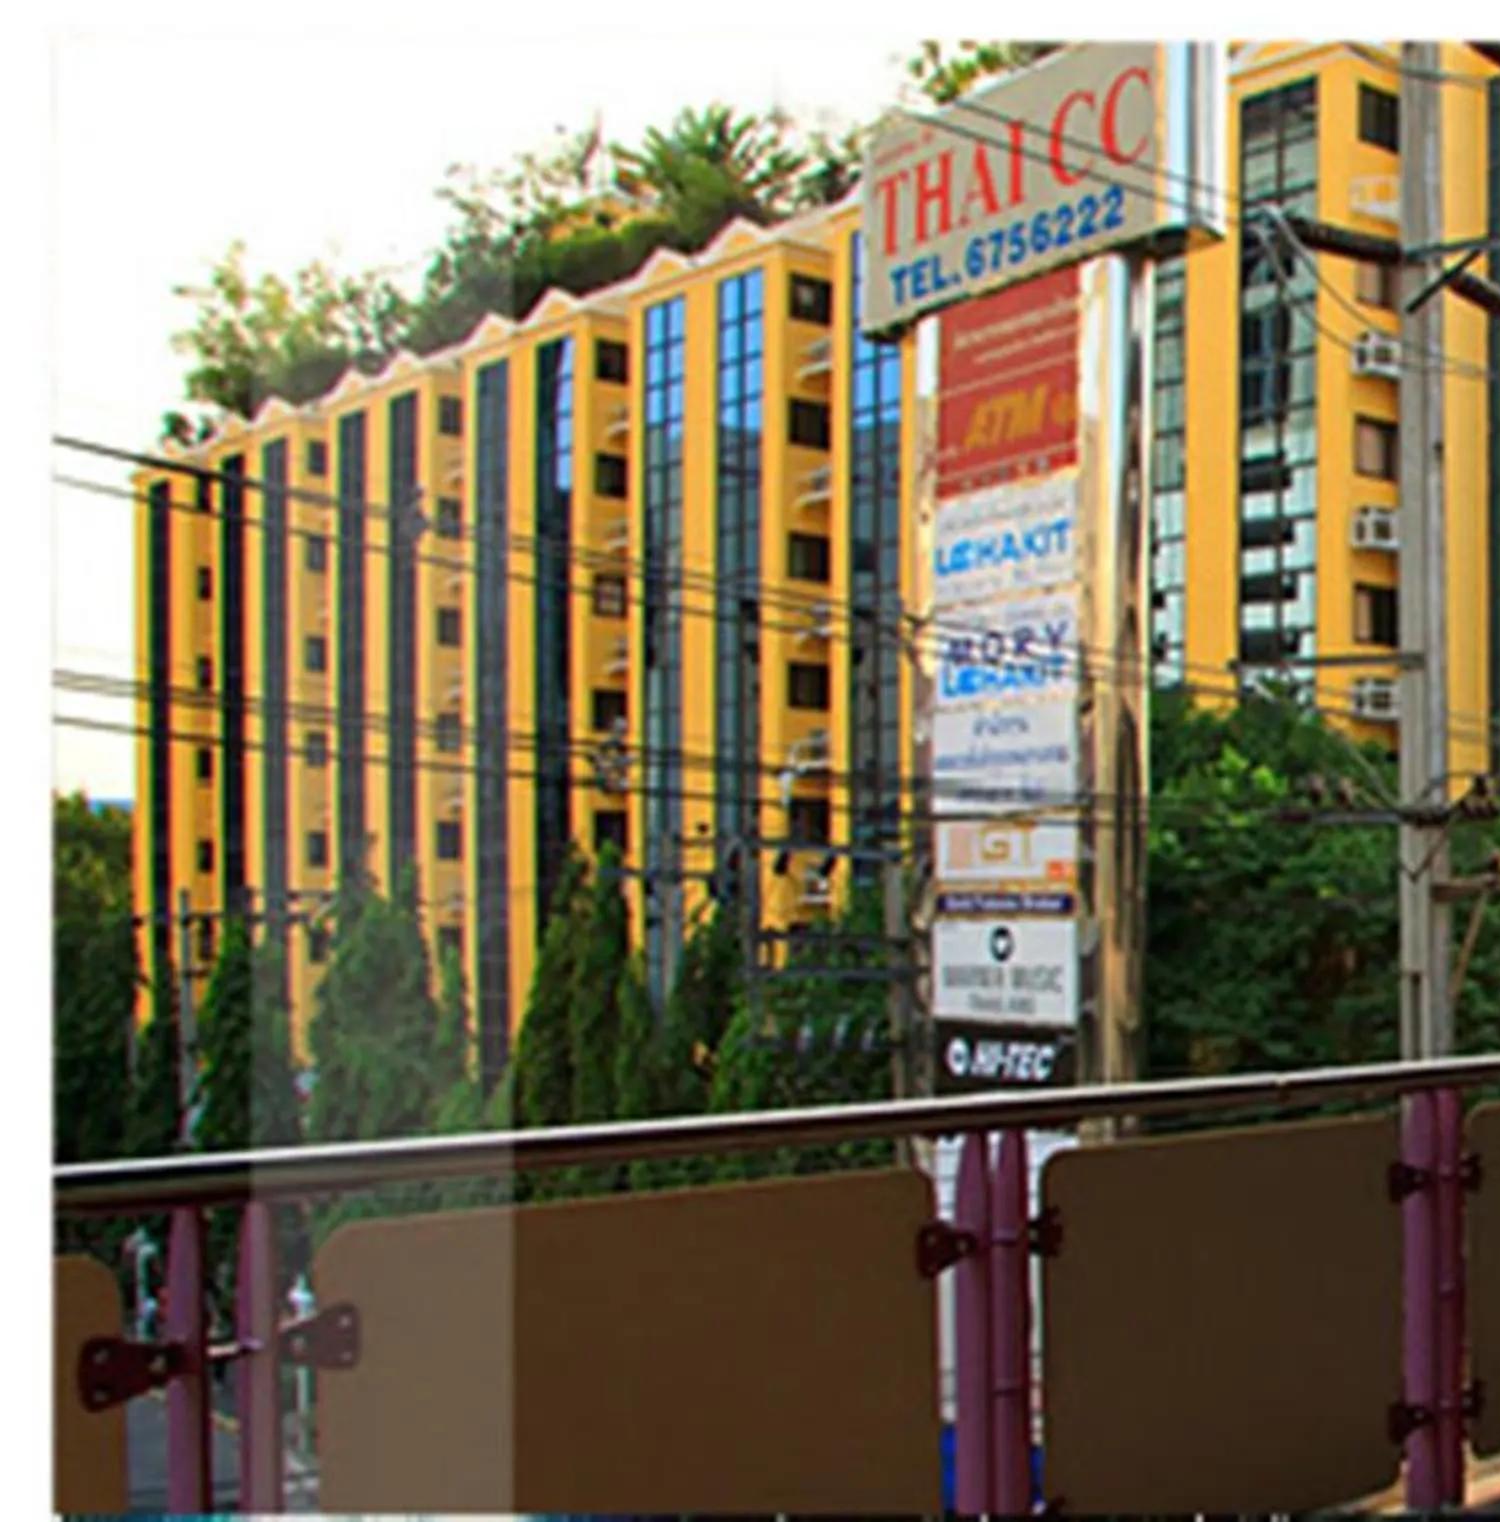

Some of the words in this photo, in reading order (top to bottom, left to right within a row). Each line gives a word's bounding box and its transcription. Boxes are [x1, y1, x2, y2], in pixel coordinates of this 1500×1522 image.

[875, 120, 1025, 256] THAI
[1050, 66, 1151, 187] CC
[963, 382, 1049, 449] ATM
